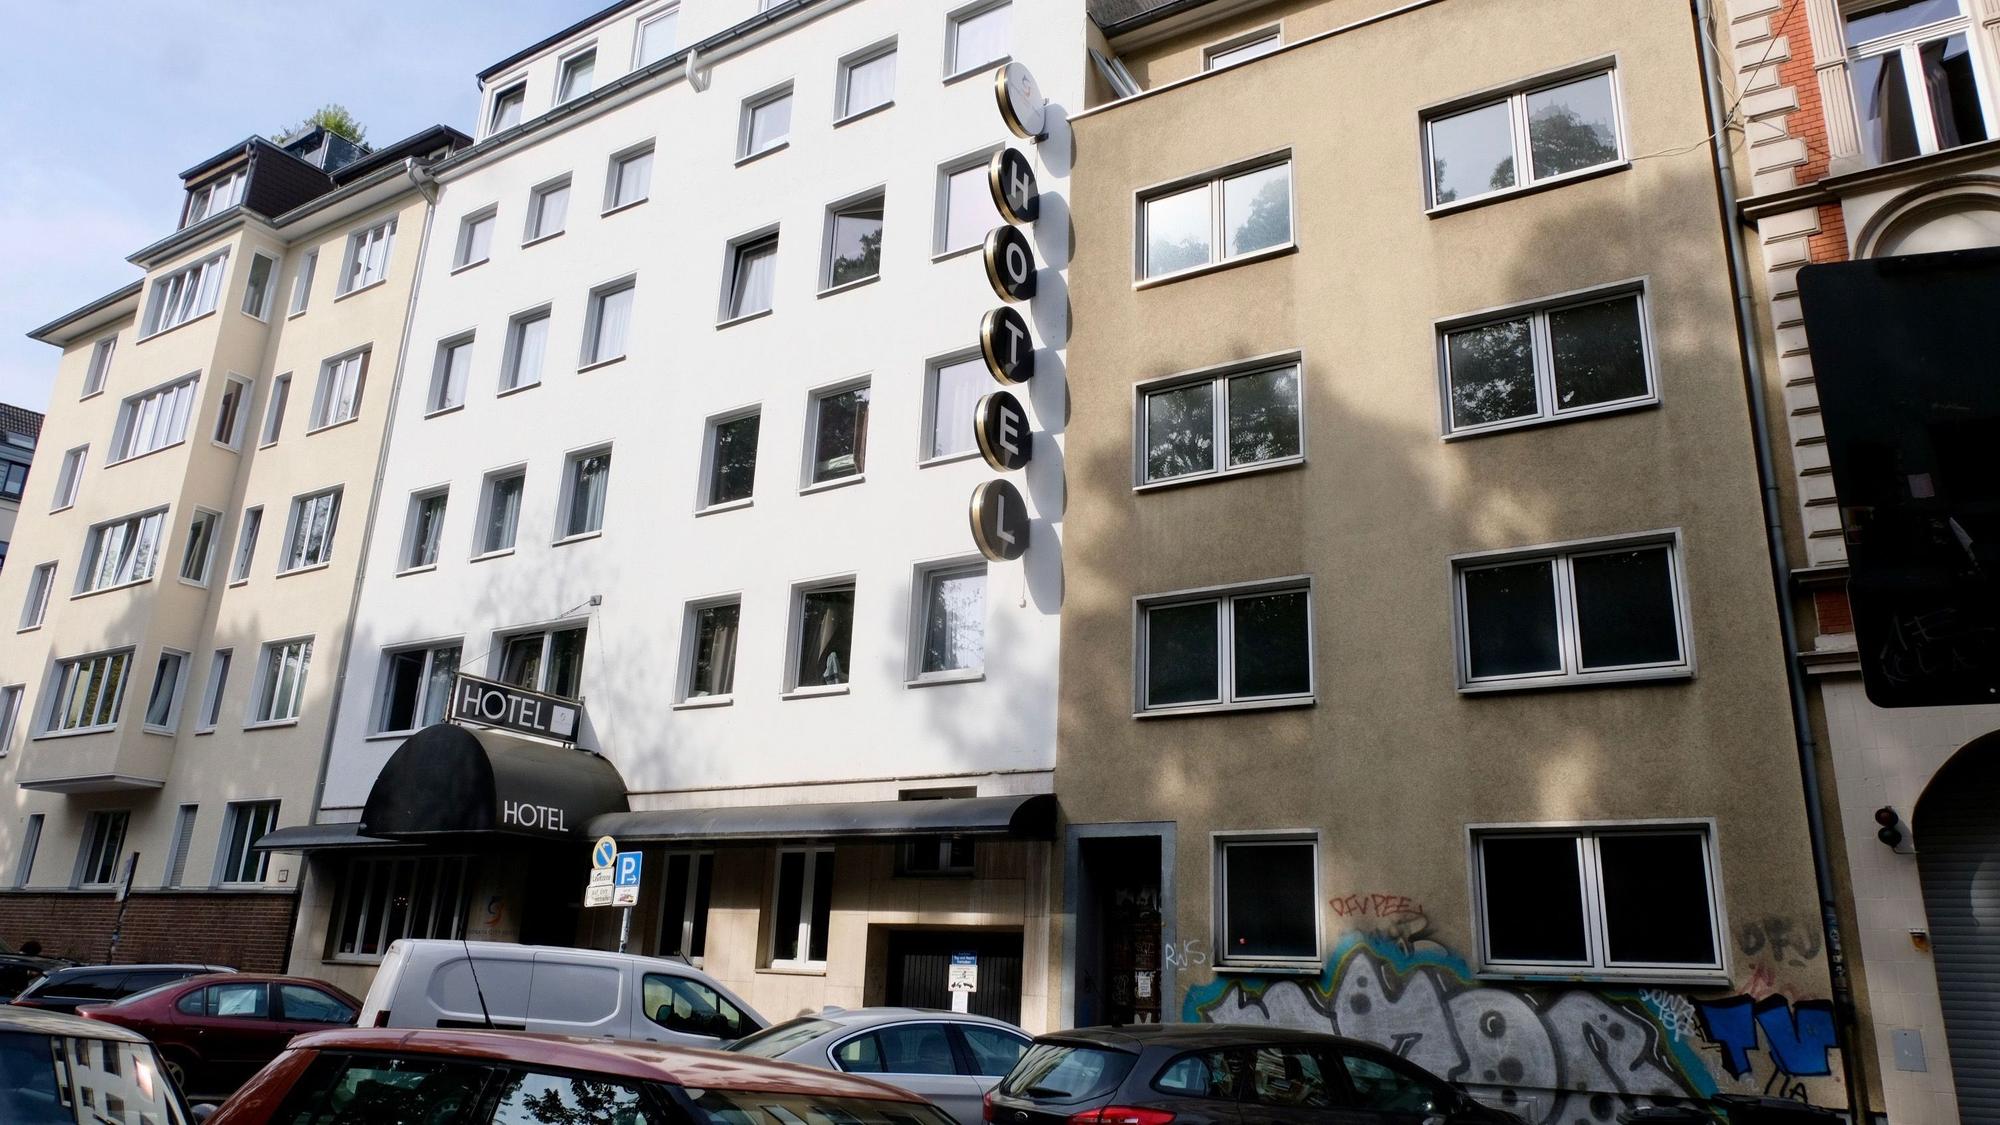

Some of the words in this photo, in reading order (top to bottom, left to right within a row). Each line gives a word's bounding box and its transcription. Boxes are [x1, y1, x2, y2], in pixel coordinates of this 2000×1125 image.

[997, 160, 1030, 545] HOTEL
[462, 684, 545, 730] HOTEL
[503, 800, 569, 832] HOTEL
[621, 857, 636, 885] P
